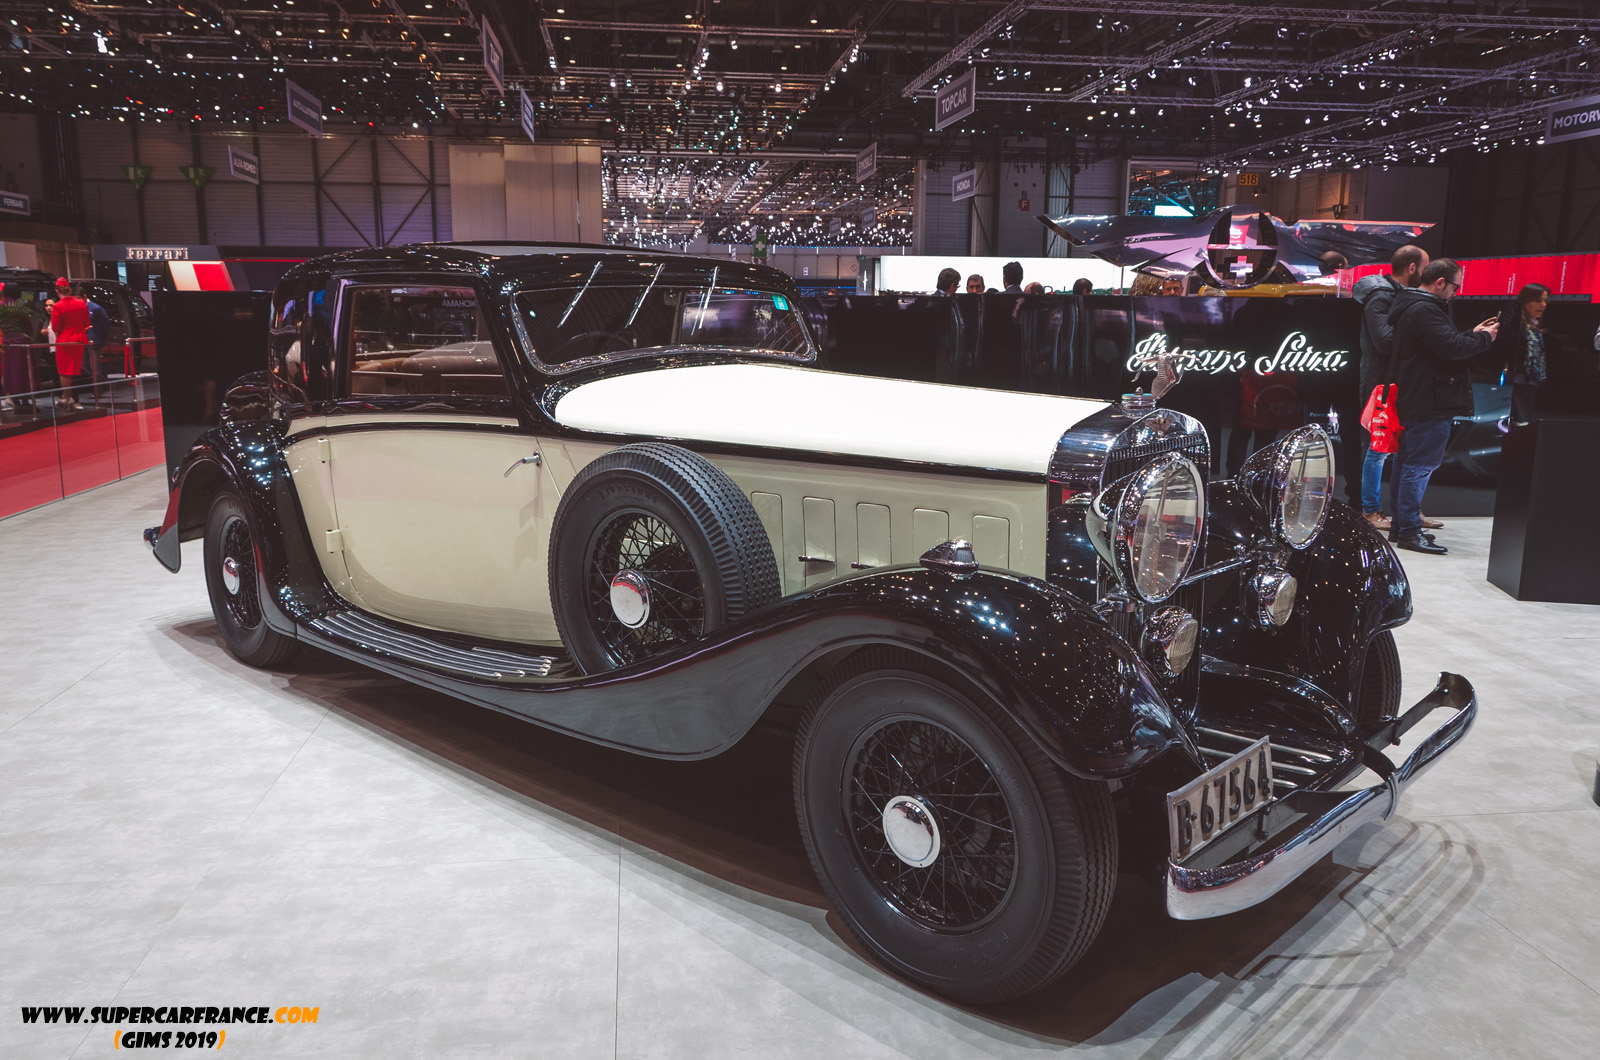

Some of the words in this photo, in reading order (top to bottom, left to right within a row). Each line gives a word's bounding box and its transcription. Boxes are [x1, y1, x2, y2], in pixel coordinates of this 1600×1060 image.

[942, 87, 967, 115] TOPCAR
[1554, 109, 1600, 129] MOTOR
[1240, 174, 1258, 185] 518
[1022, 200, 1028, 209] F
[126, 247, 189, 260] Ferrari
[1126, 332, 1247, 376] Hspano
